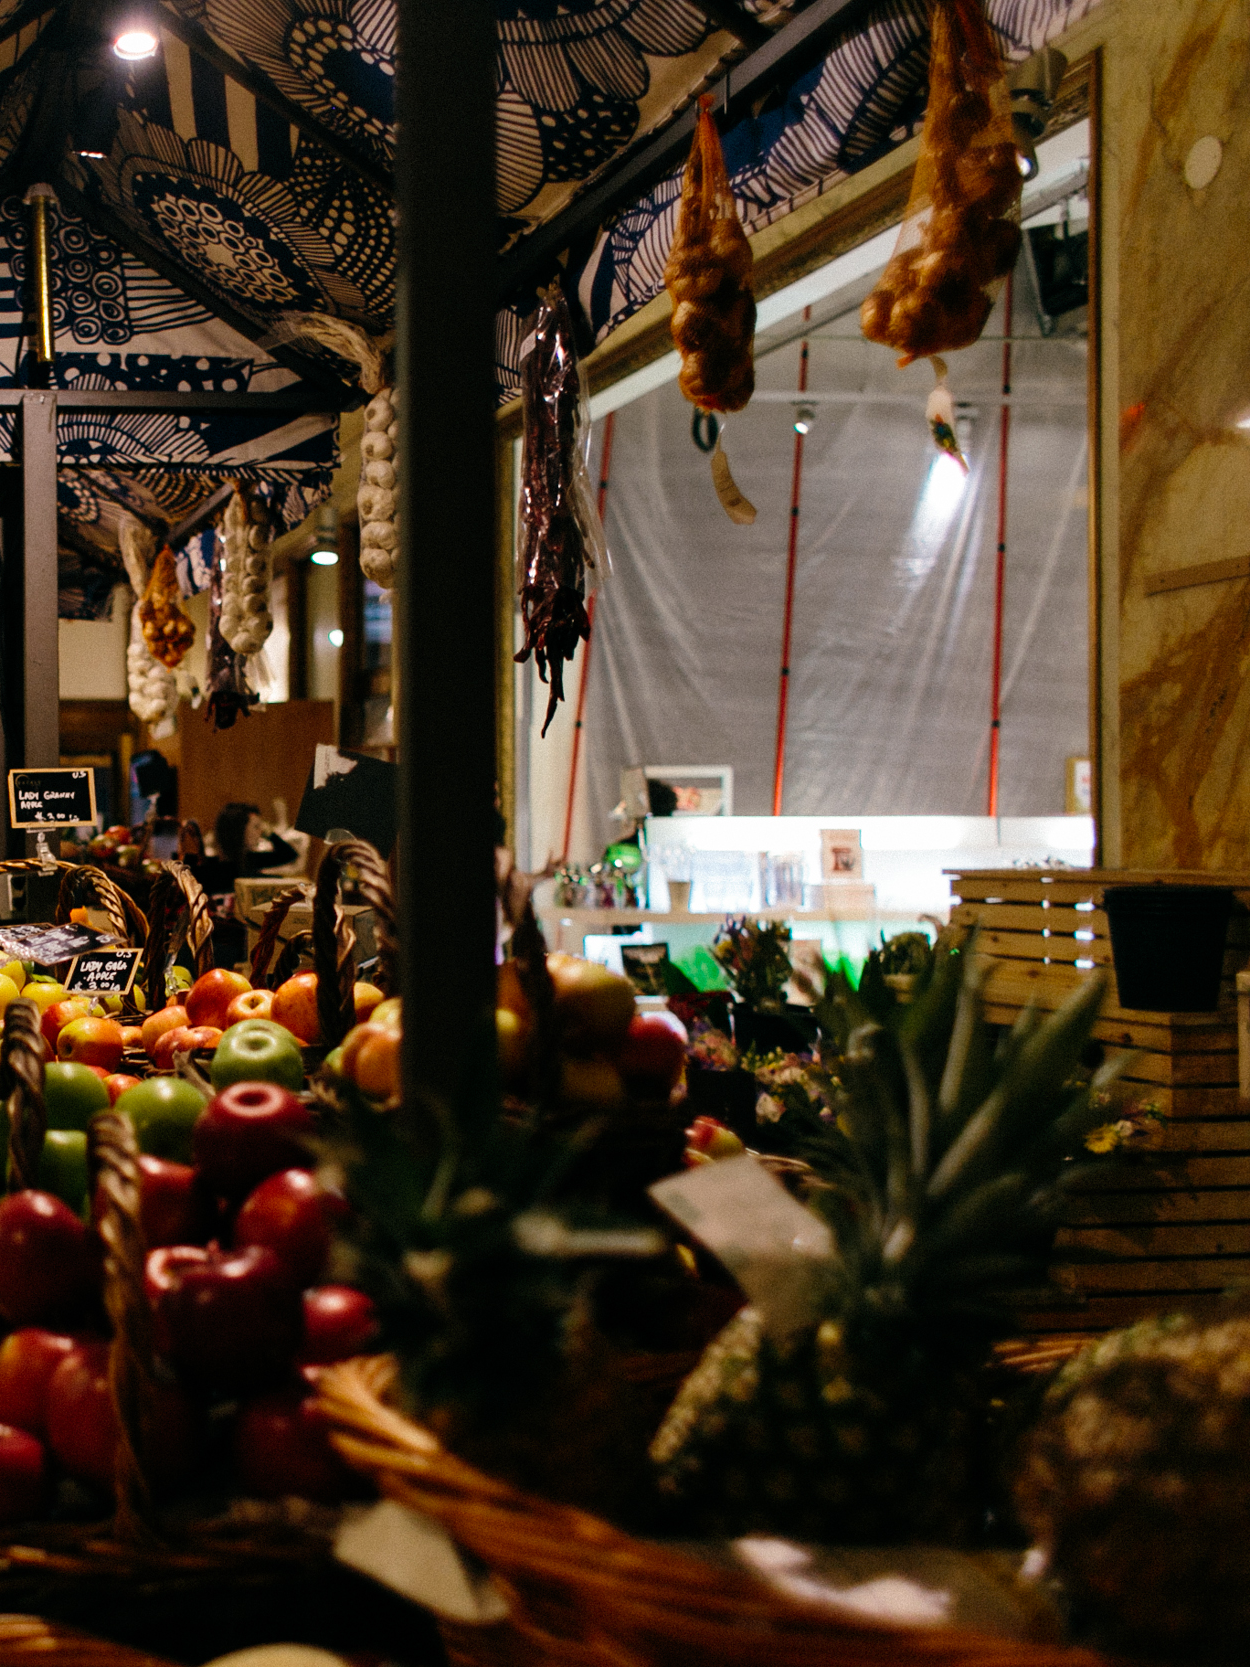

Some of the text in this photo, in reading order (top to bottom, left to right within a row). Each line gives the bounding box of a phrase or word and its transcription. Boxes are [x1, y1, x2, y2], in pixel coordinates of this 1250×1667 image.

[18, 789, 40, 801] LADY
[80, 960, 128, 973] LADY GALA
